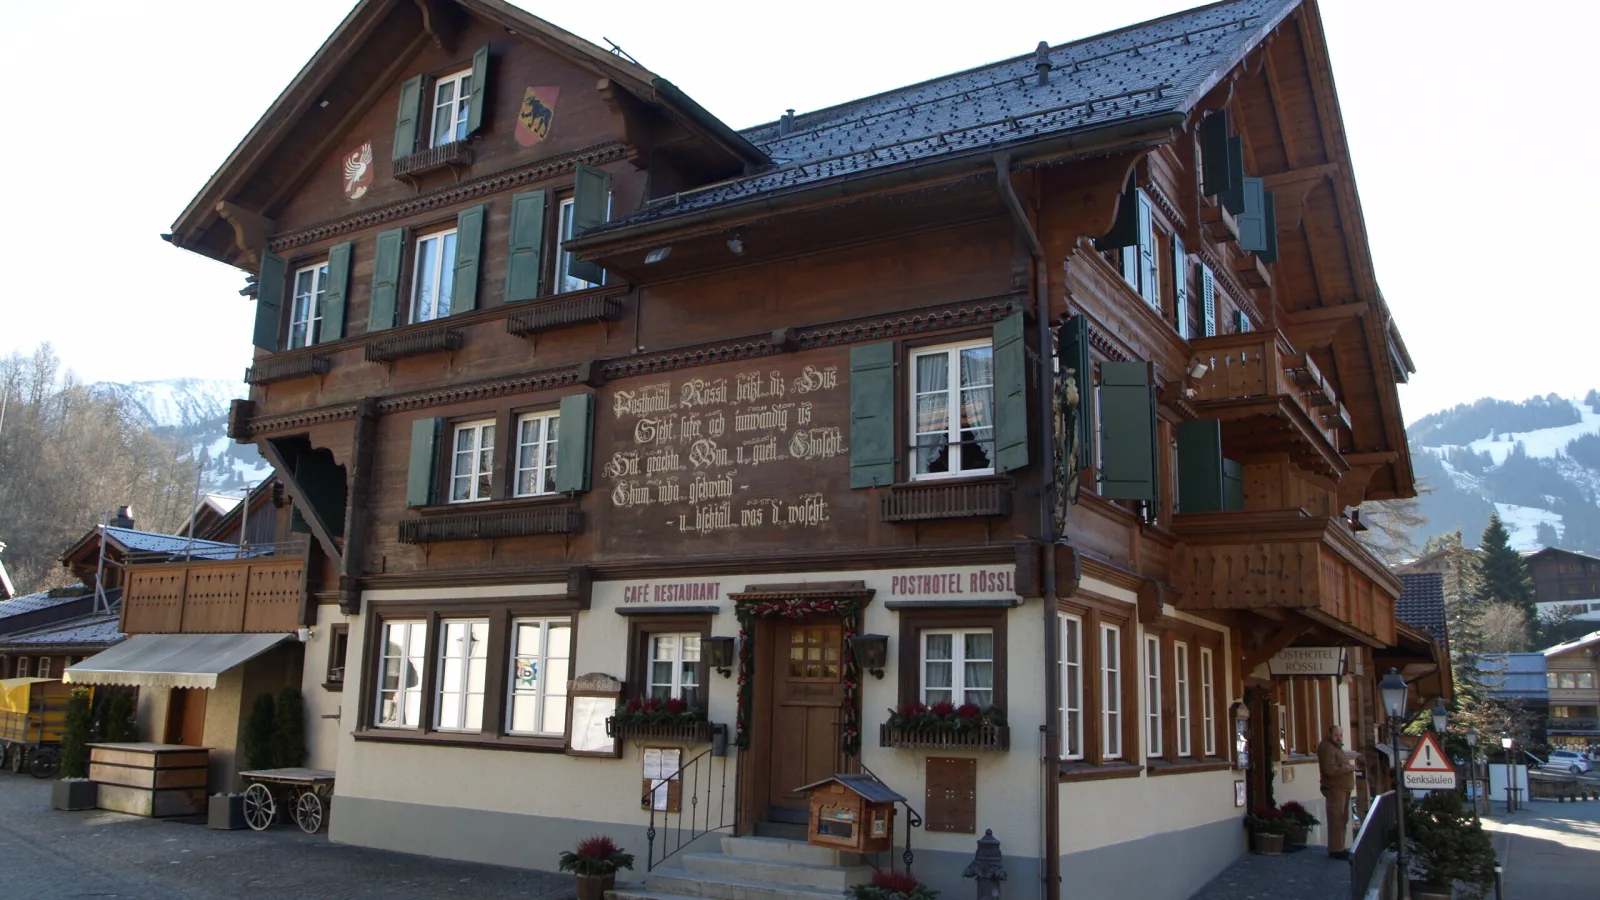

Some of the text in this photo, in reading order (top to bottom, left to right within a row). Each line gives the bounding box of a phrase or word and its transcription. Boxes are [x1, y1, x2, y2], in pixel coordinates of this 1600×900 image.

[680, 379, 727, 409] Rössli
[792, 365, 838, 394] Hus
[708, 410, 725, 438] och
[624, 582, 720, 603] CAFÉ RESTAURANT
[892, 574, 963, 595] POSTHOTEL
[1277, 650, 1334, 660] OSTHOTEL
[1286, 661, 1324, 672] RÖSSLI
[1406, 774, 1453, 784] Senksäulen
